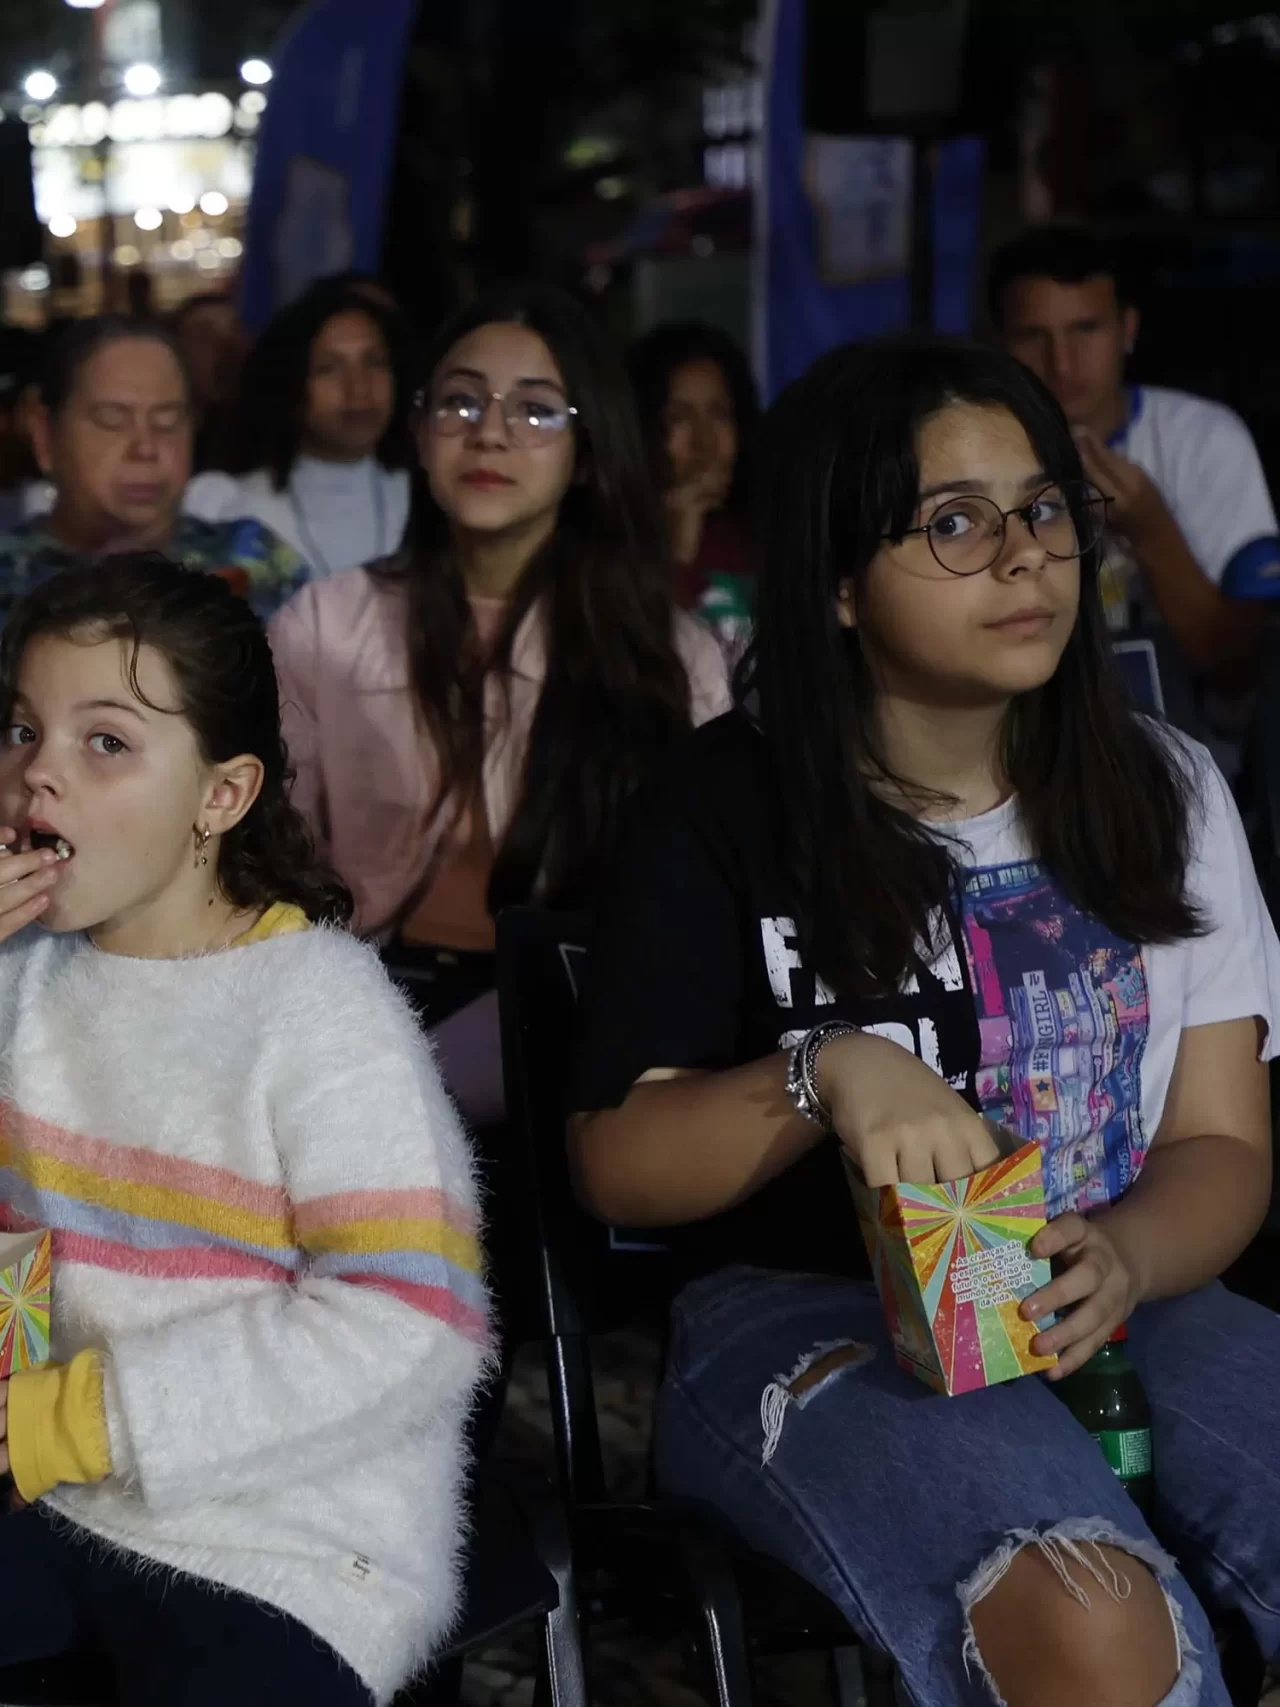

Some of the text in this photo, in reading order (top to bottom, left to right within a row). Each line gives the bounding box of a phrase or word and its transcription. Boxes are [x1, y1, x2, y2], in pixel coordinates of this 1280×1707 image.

[971, 1248, 1004, 1261] crianças
[960, 1261, 1001, 1277] esperança
[1004, 1254, 1022, 1264] para
[991, 1268, 1019, 1279] sorriso
[958, 1288, 985, 1301] mundo
[1003, 1276, 1030, 1288] alegria
[993, 1294, 1009, 1302] vida
